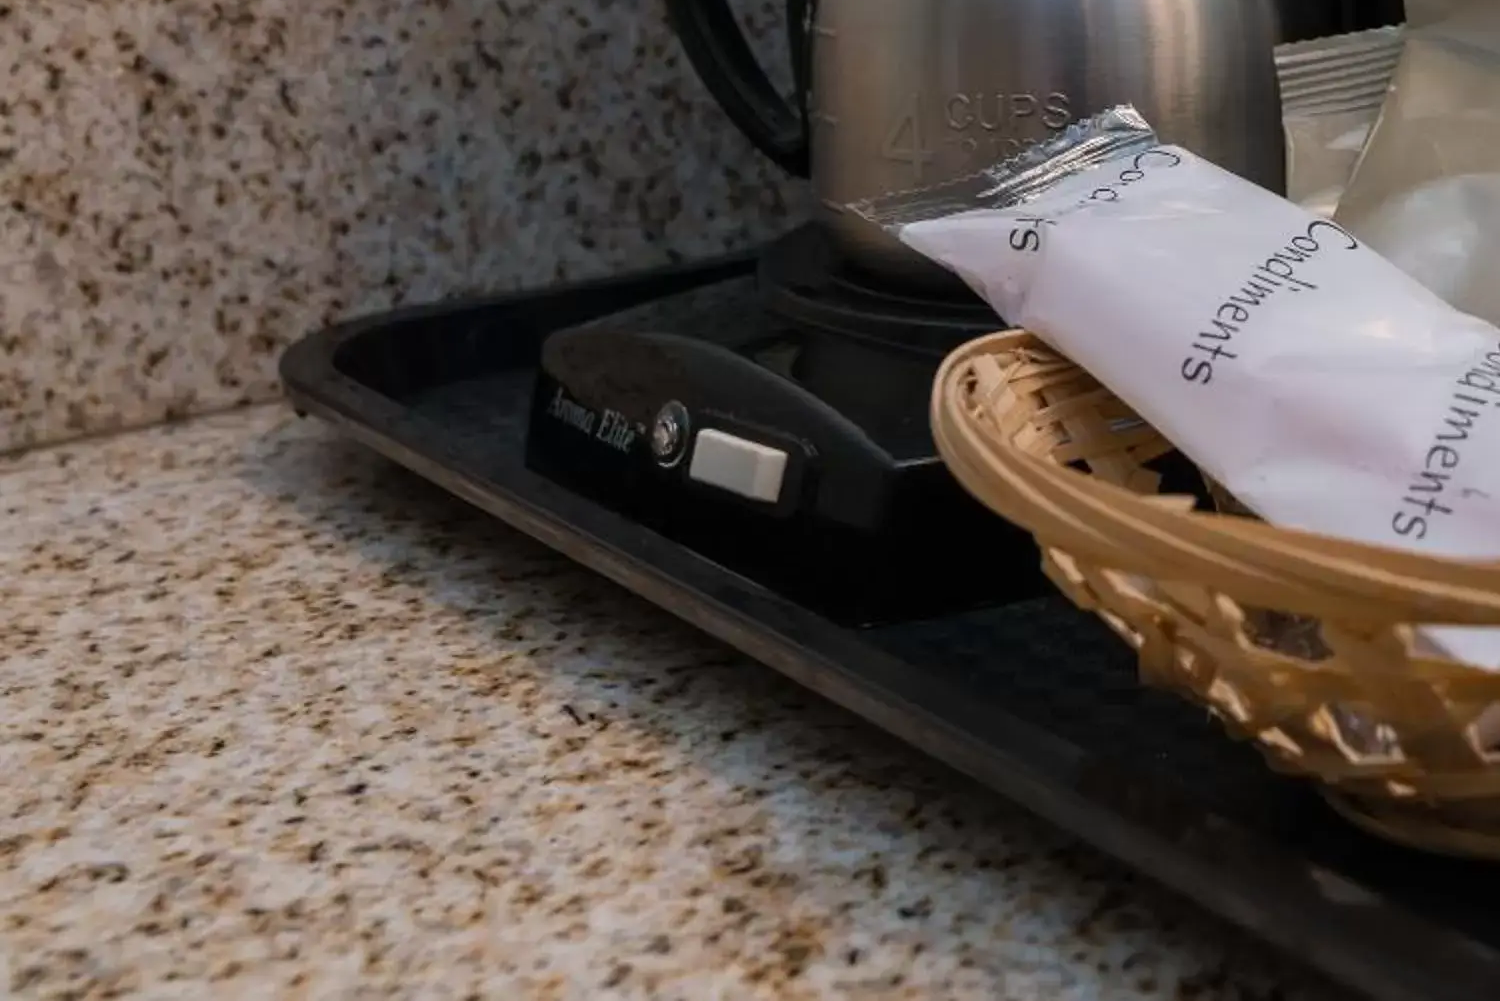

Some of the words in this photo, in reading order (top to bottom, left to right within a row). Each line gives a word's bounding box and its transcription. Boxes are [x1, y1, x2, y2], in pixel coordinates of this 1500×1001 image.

[882, 90, 936, 179] 4
[945, 91, 1072, 131] CUPS
[1181, 219, 1360, 385] Condiments
